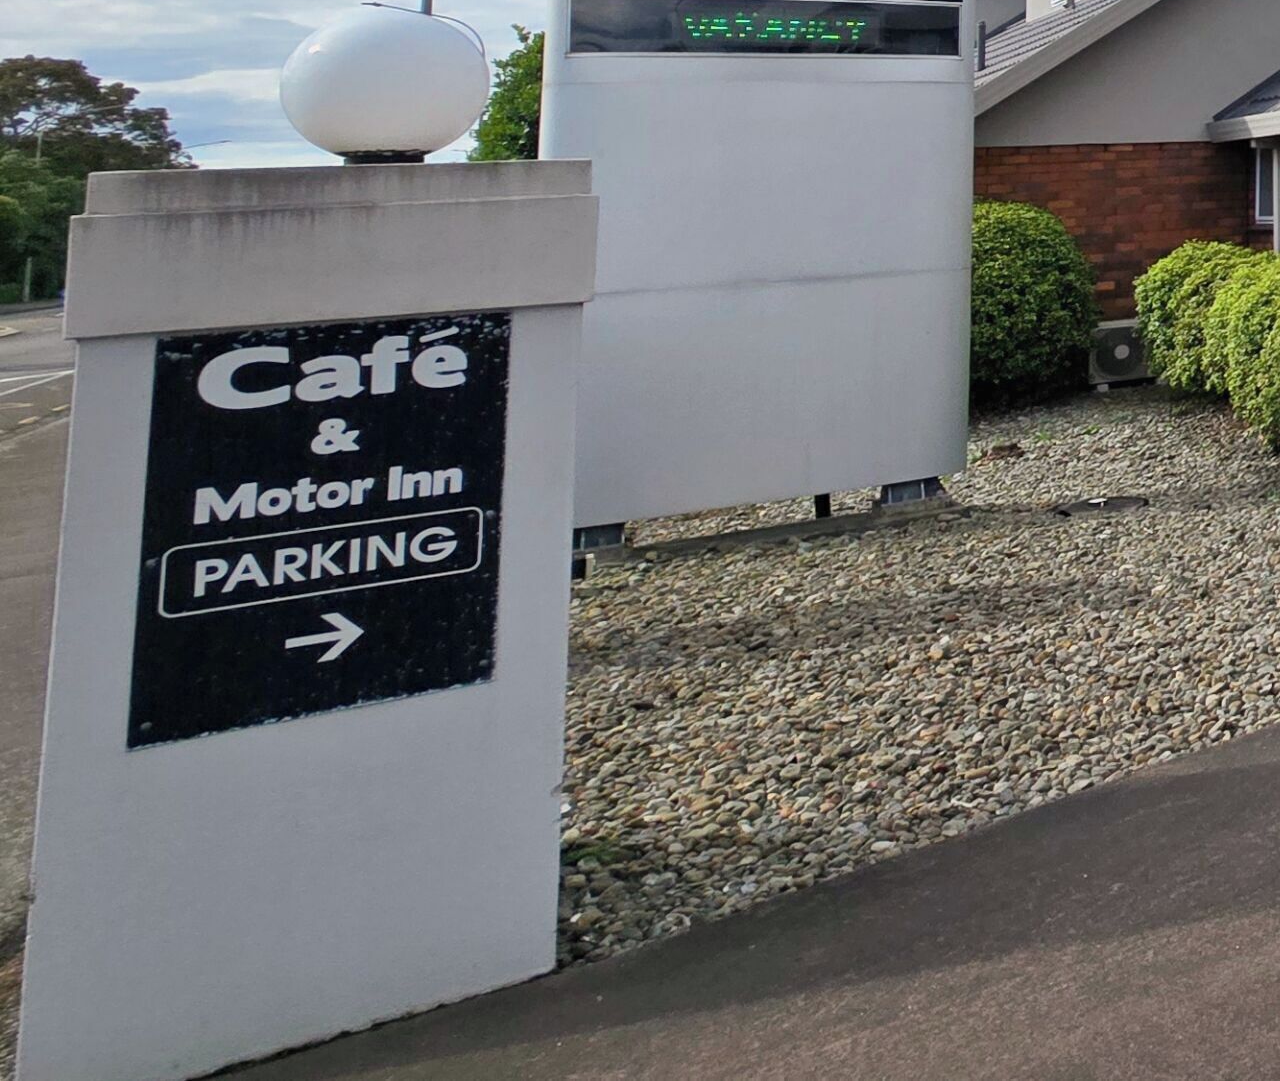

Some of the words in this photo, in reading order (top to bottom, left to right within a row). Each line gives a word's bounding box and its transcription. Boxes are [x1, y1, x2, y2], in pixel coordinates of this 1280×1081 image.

[198, 326, 469, 410] Café
[310, 418, 360, 455] &
[193, 474, 375, 525] Motor
[386, 465, 464, 501] Inn
[193, 526, 459, 598] PARKING
